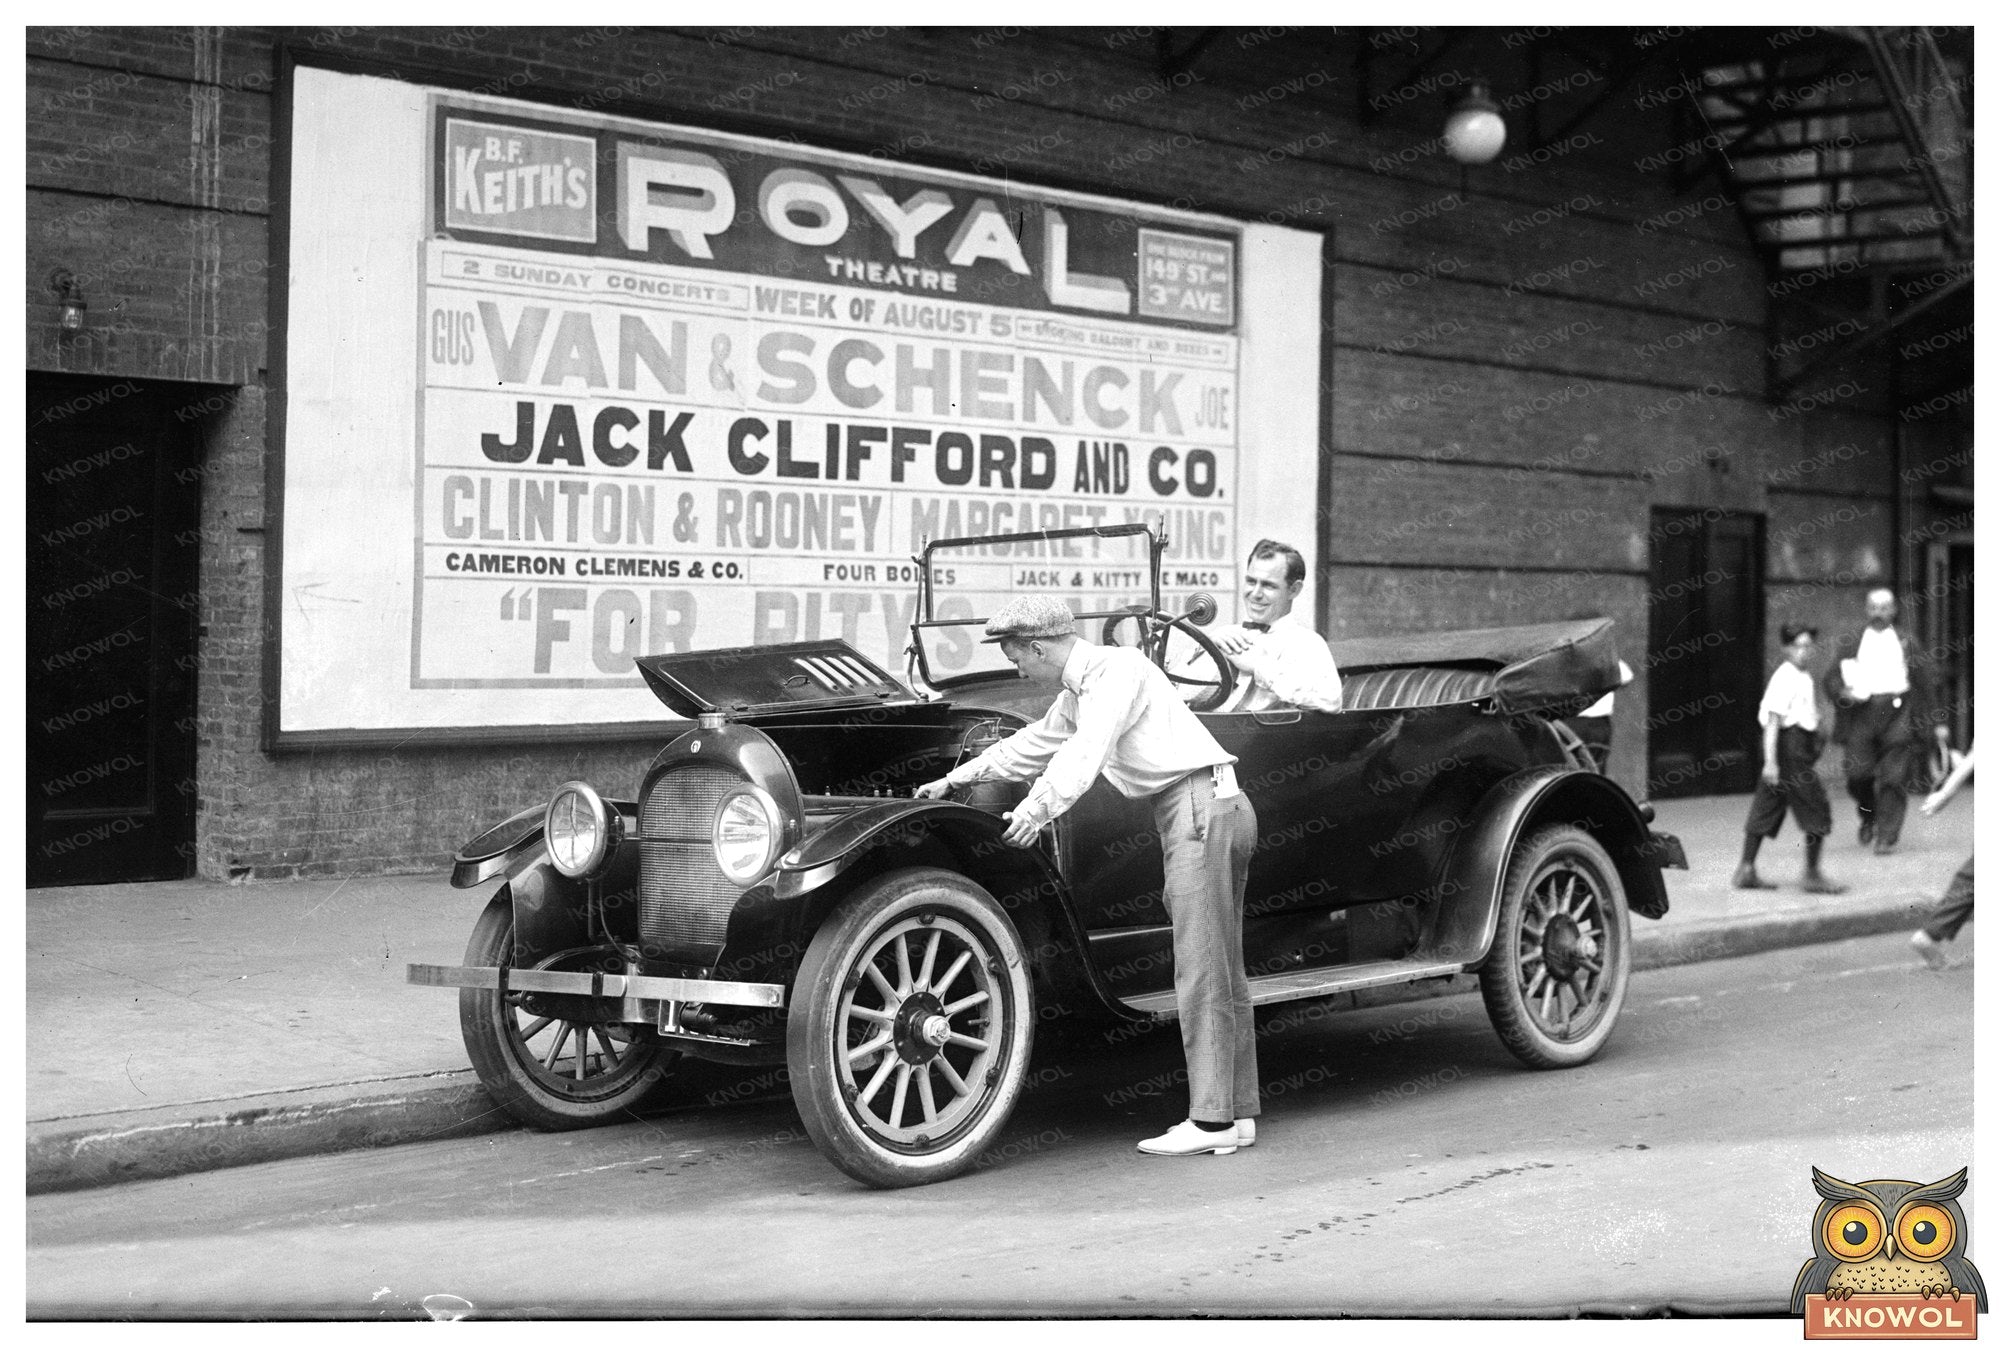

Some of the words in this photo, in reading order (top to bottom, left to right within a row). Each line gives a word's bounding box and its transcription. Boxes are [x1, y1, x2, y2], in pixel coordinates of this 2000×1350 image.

[485, 136, 523, 165] B.F.
[455, 145, 588, 215] KEITH'S
[617, 141, 1131, 314] ROYAL
[463, 260, 480, 276] 2
[494, 264, 591, 288] SUNDAY
[606, 273, 731, 303] CONCERTS
[824, 254, 958, 292] THEATRE
[755, 286, 838, 320] WEEK
[849, 297, 876, 323] OF
[883, 301, 983, 334] AUGUST
[989, 313, 1013, 338] 5
[431, 308, 476, 366] GUS
[477, 301, 689, 395] VAN
[708, 332, 737, 392] &
[755, 330, 1186, 437] SCHENCK
[1195, 383, 1230, 432] JOE
[481, 401, 696, 473] JACK
[727, 416, 1056, 490] CLIFFORD
[1073, 440, 1130, 495] AND
[1148, 446, 1224, 499] CO.
[442, 474, 656, 546] CLINTON
[672, 491, 699, 544] &
[716, 486, 883, 553] ROONEY
[910, 497, 1107, 559] MARGARET
[446, 552, 566, 576] CAMERON
[575, 556, 681, 579] CLEMENS
[687, 561, 704, 579] &
[712, 562, 744, 580] CO.
[823, 563, 876, 582] FOUR
[886, 565, 956, 586] BOIES
[1016, 570, 1061, 587] JACK
[1071, 572, 1083, 587] &
[1093, 571, 1142, 587] KITTY
[1175, 571, 1219, 587] MACO
[753, 590, 975, 671] PITYS
